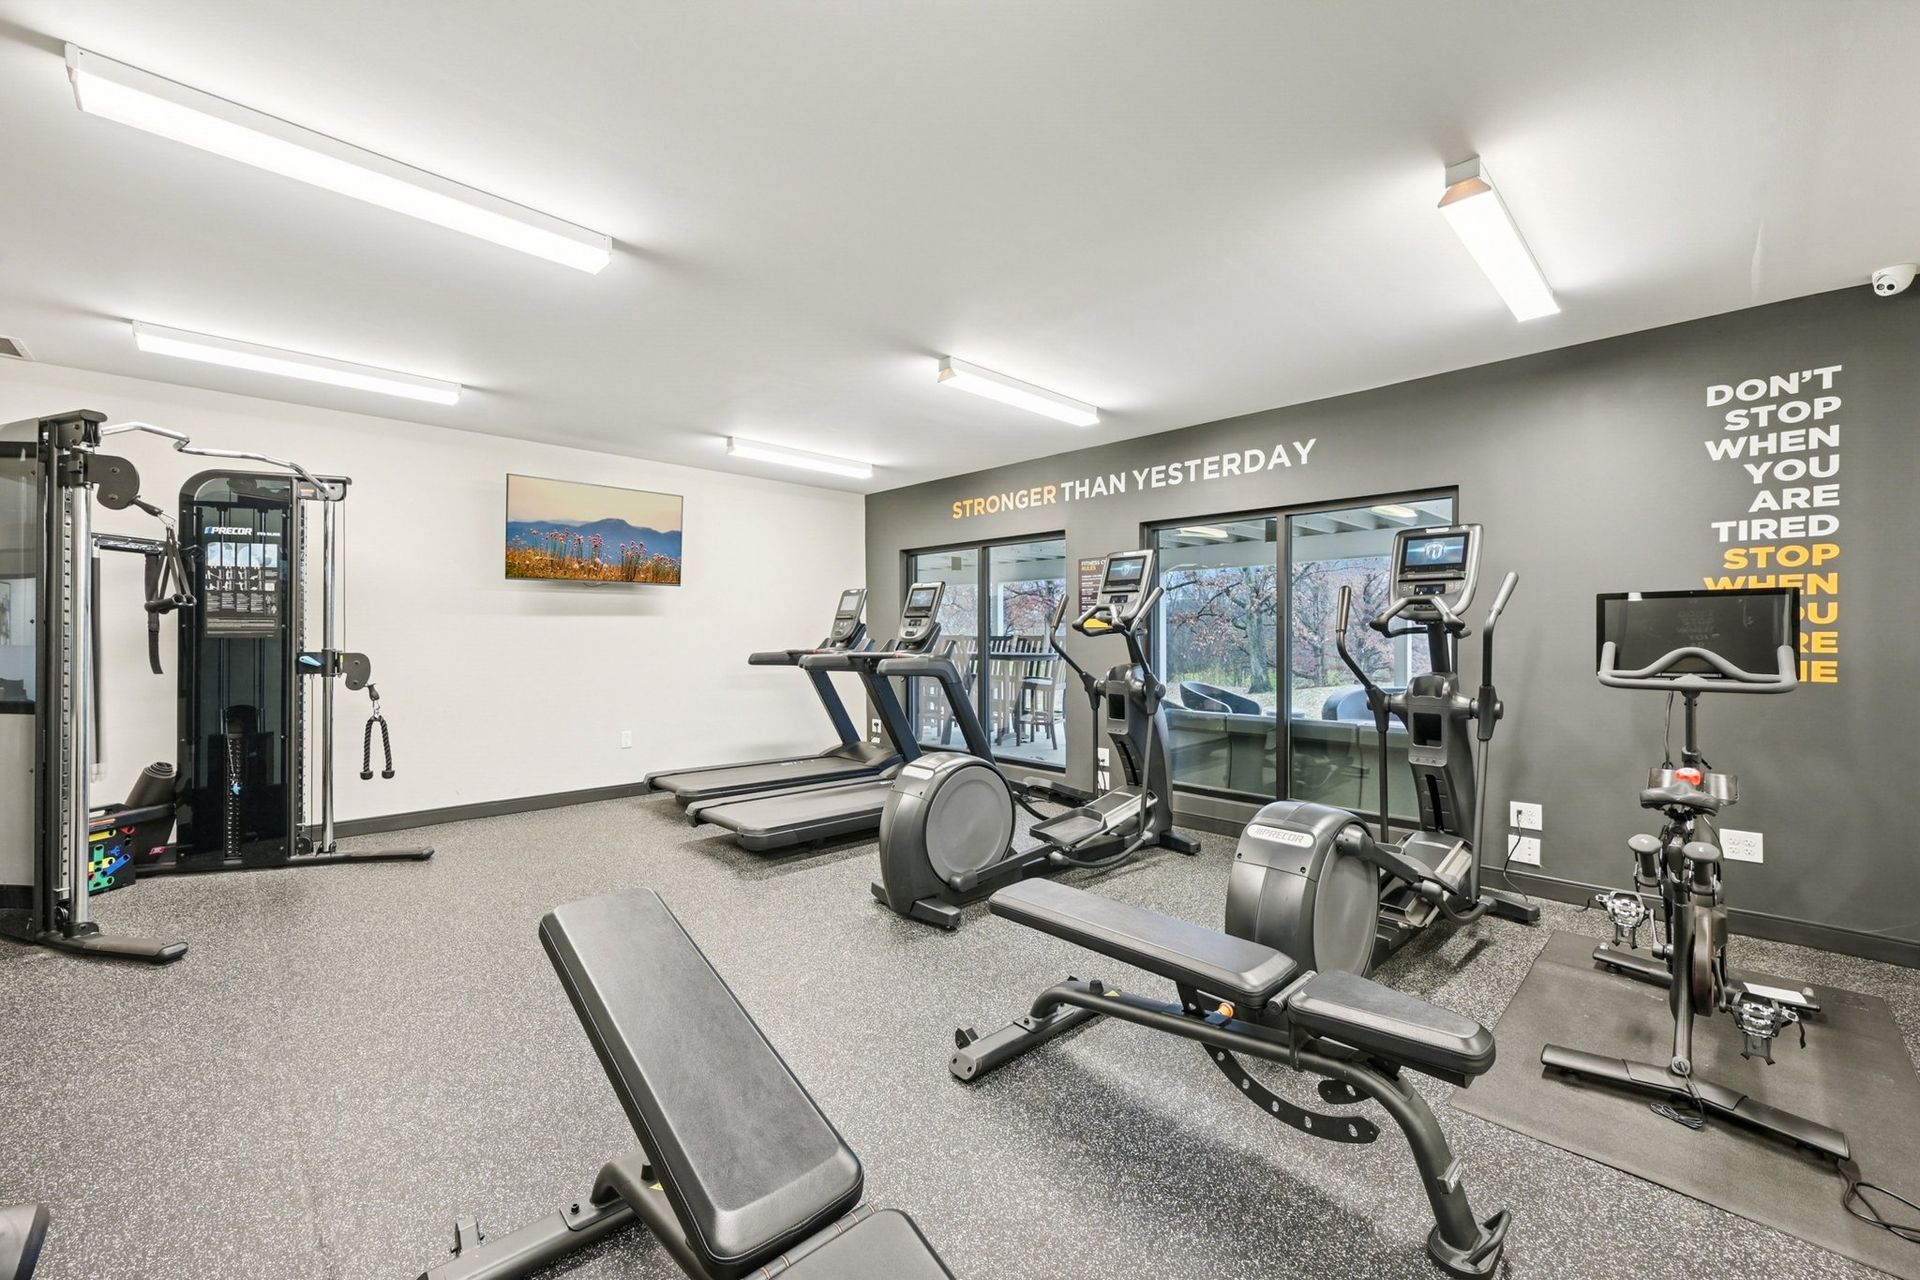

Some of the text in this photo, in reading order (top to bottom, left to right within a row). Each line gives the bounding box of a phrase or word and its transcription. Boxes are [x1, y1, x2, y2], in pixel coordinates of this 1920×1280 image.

[1706, 365, 1842, 407] DON'T
[1724, 396, 1842, 431] STOP
[1704, 424, 1840, 461] WHEN
[952, 438, 1317, 519] STRONGER THAN YESTERDAY
[1743, 454, 1840, 484] YOU
[1748, 484, 1840, 513] ARE
[211, 526, 252, 536] PRECOR
[1711, 514, 1840, 543] TIRED
[1723, 543, 1841, 570] STOP
[1263, 828, 1304, 843] PRECOR
